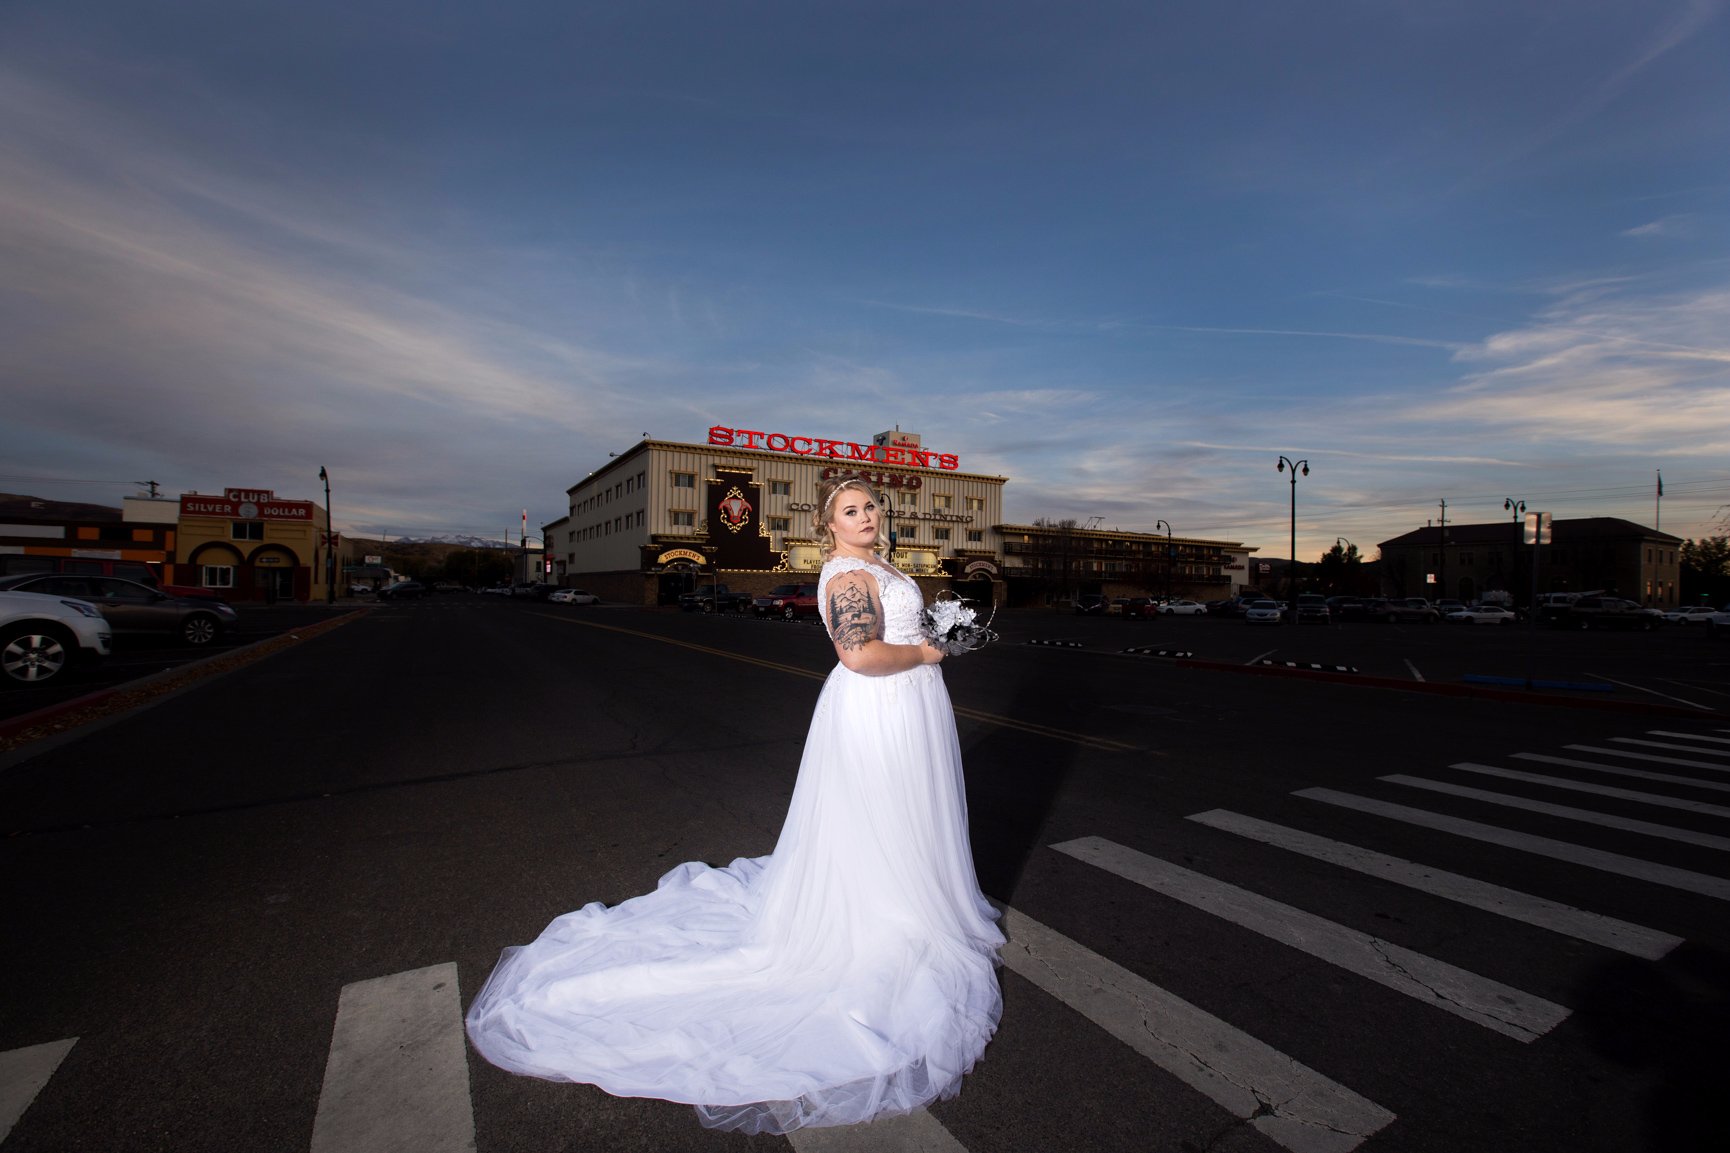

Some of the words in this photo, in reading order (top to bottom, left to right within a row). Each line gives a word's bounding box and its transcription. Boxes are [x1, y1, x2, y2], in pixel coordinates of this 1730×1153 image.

[708, 426, 959, 470] STOCKMEN'S
[229, 491, 269, 503] CLUB
[186, 502, 232, 513] SILVER
[263, 506, 307, 517] DOLLAR
[922, 512, 975, 523] DINING
